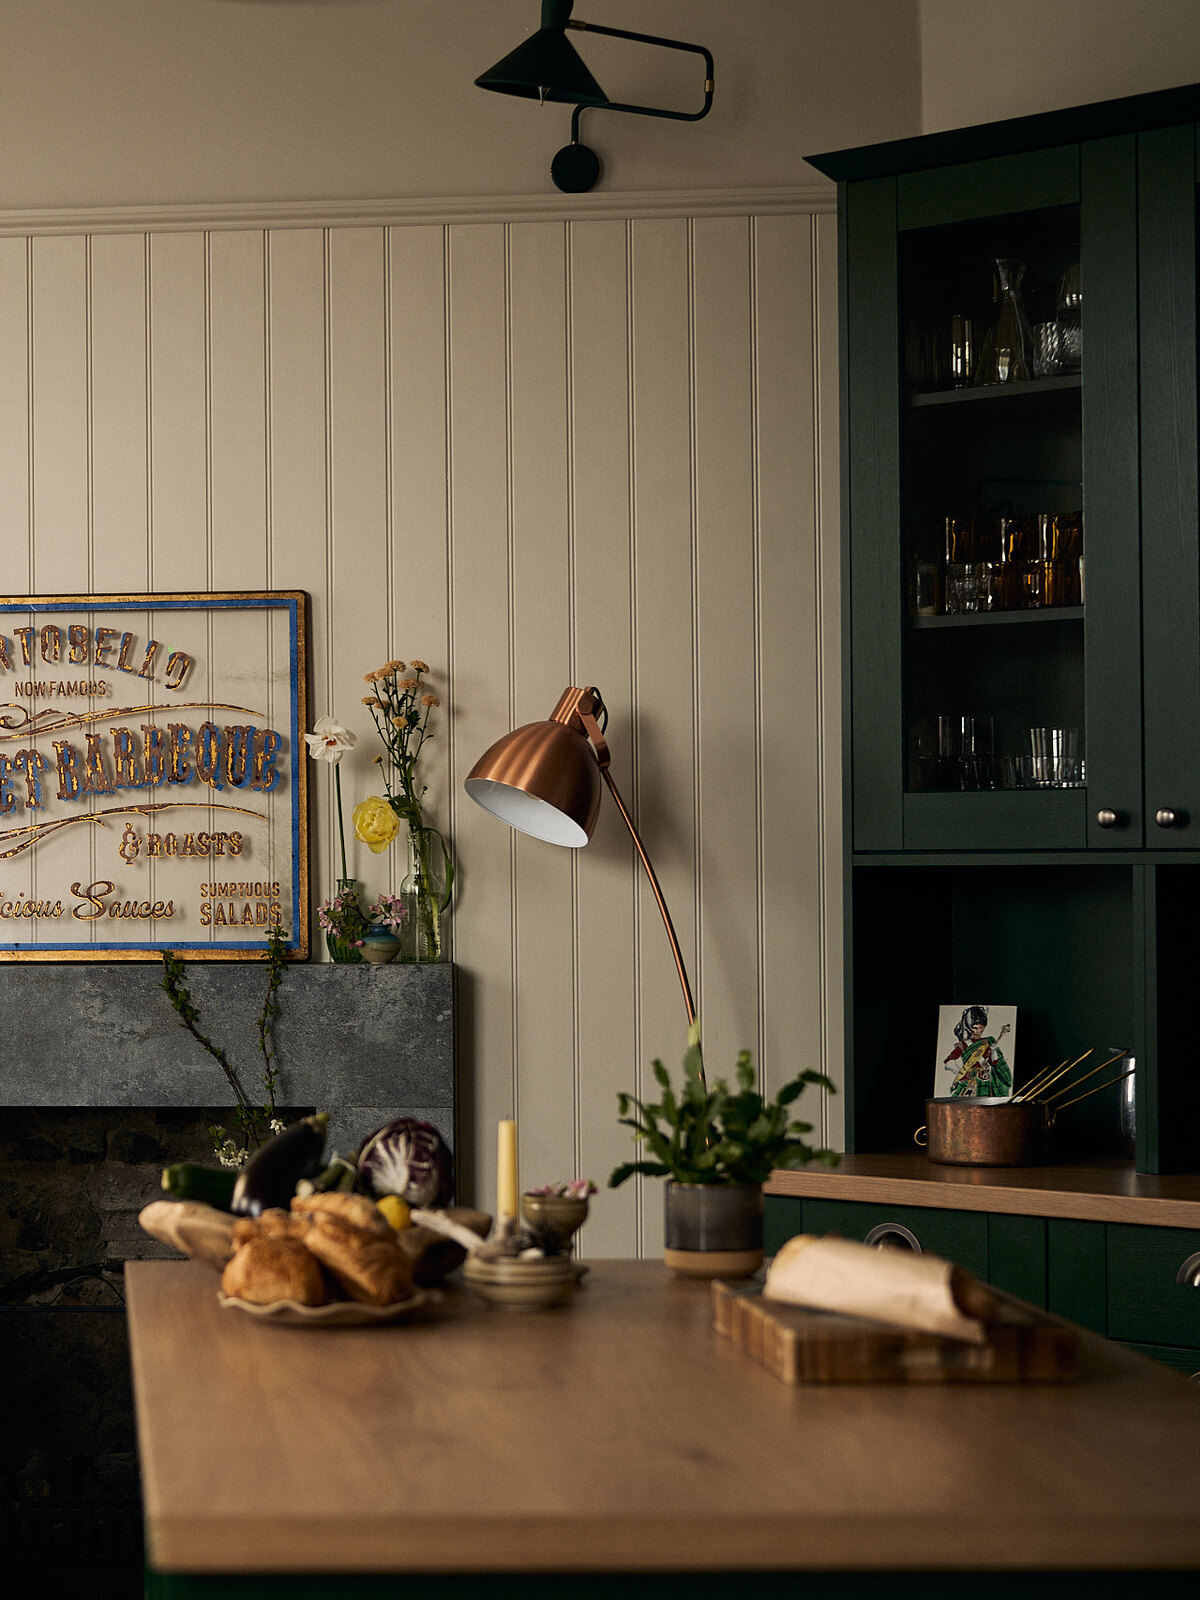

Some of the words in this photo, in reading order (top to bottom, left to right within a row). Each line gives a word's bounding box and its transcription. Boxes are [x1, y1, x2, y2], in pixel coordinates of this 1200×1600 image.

[14, 681, 46, 697] NOW
[49, 680, 107, 697] FAMOUS
[52, 722, 282, 801] BARBEQUE
[119, 822, 143, 866] &
[146, 831, 243, 858] ROASTS
[70, 880, 176, 921] Sauces
[200, 881, 281, 899] SUMPTUOUS
[200, 902, 282, 927] SALADS
